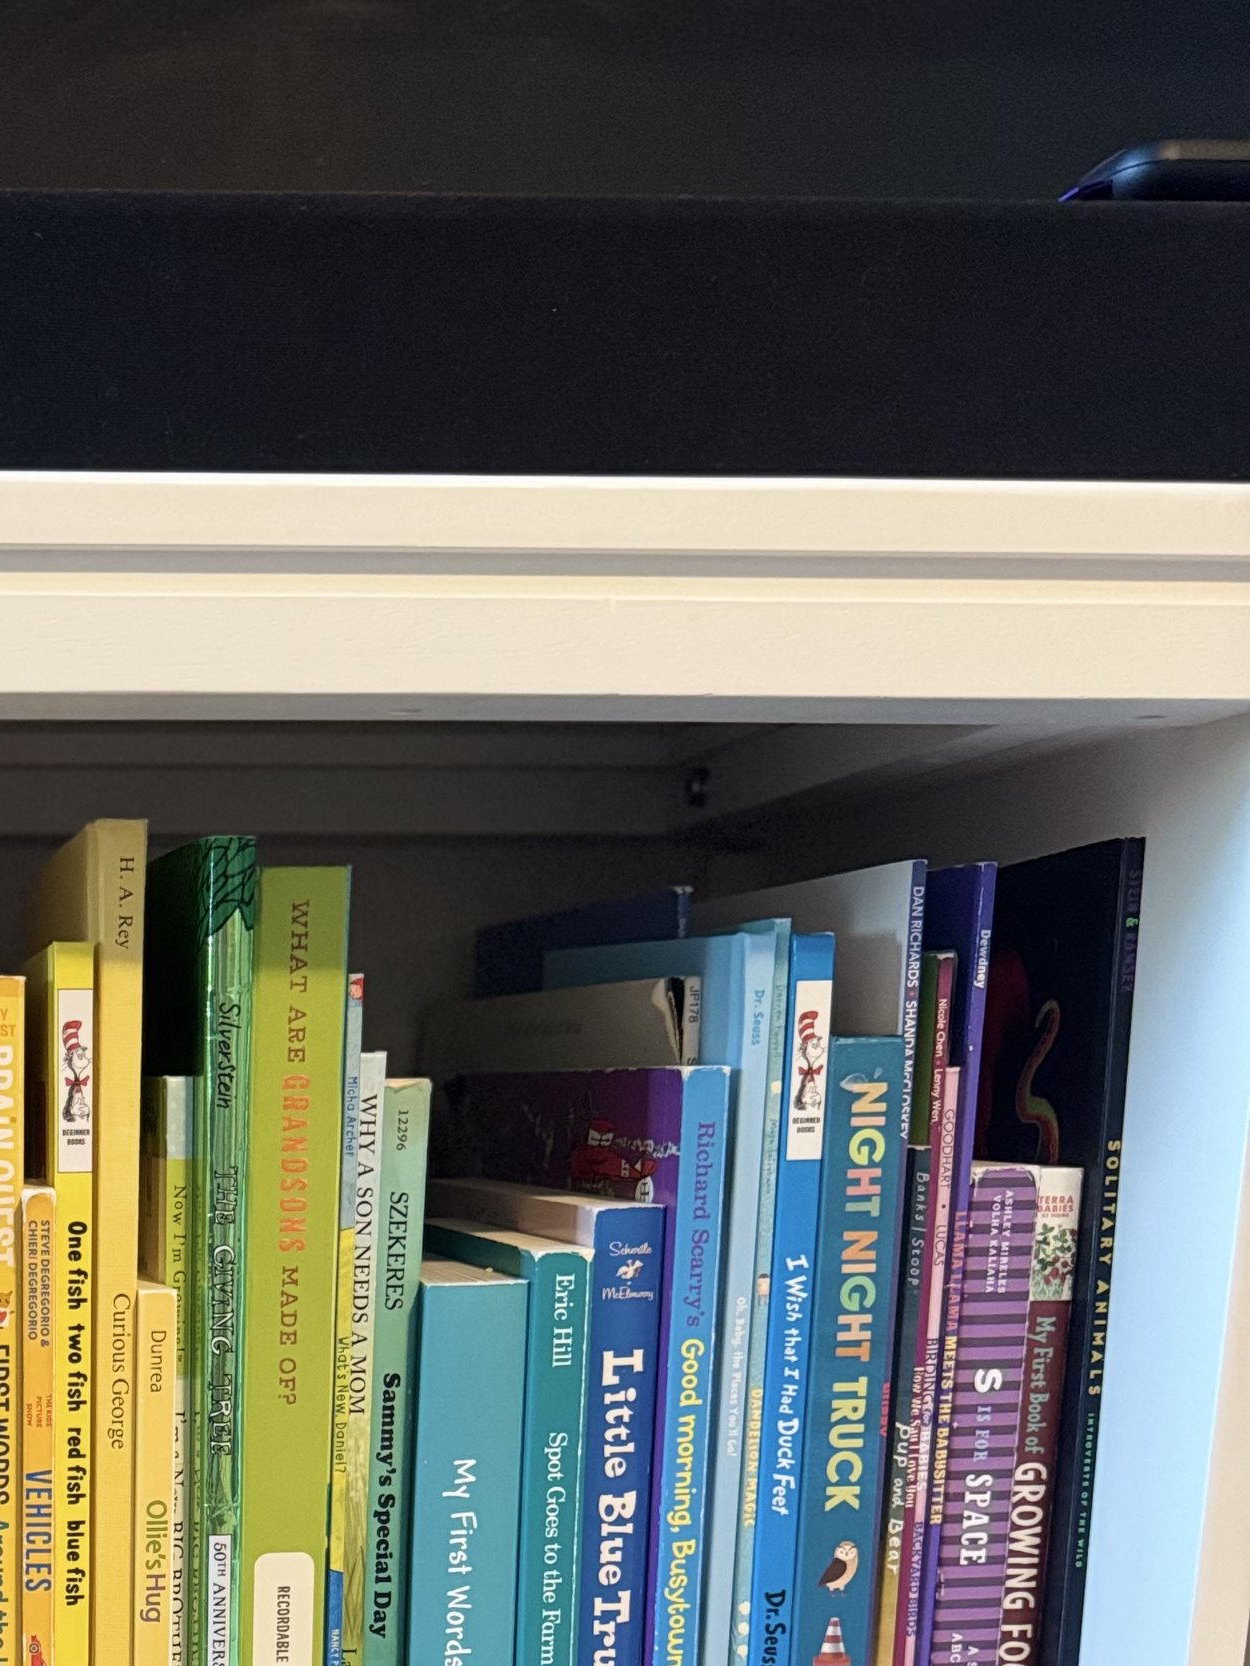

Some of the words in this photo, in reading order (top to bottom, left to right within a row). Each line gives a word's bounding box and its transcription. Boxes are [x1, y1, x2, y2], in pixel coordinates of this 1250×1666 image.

[119, 857, 134, 879] H.
[118, 887, 134, 908] A.
[116, 915, 133, 949] Rey
[291, 899, 310, 992] WHAT
[975, 930, 991, 988] Dewdney
[287, 1005, 307, 1063] ARE
[359, 1095, 377, 1154] WHY
[279, 1074, 311, 1252] GRANDSONS
[358, 1162, 373, 1177] A
[693, 1121, 715, 1220] Richard
[845, 1082, 888, 1217] NIGHT
[213, 1166, 239, 1225] THE
[356, 1187, 374, 1236] SON
[1098, 1140, 1121, 1265] SOLITARY
[67, 1221, 87, 1262] One
[385, 1191, 409, 1310] SZEKERES
[786, 1255, 809, 1270] I
[68, 1269, 88, 1309] fish
[211, 1245, 235, 1355] GIVING
[352, 1245, 371, 1323] NEEDS
[553, 1273, 574, 1320] Eric
[684, 1229, 710, 1327] Scarry's
[784, 1275, 808, 1321] Wish
[835, 1231, 878, 1361] NIGHT
[279, 1266, 299, 1345] MADE
[1038, 1316, 1055, 1342] My
[68, 1324, 84, 1364] two
[111, 1293, 130, 1372] Curious
[351, 1332, 367, 1347] A
[552, 1327, 572, 1368] Hill
[783, 1328, 800, 1361] that
[1088, 1280, 1110, 1396] ANIMALS
[279, 1358, 296, 1405] OF?
[349, 1355, 366, 1415] MOM
[679, 1338, 704, 1406] Good
[784, 1367, 799, 1379] I
[941, 1336, 957, 1387] MEETS
[974, 1368, 1002, 1393] S
[1031, 1347, 1052, 1387] First
[68, 1372, 87, 1411] fish
[109, 1378, 130, 1449] George
[209, 1374, 233, 1456] TREE
[601, 1350, 644, 1477] Little
[779, 1384, 797, 1414] Had
[939, 1392, 953, 1423] THE
[977, 1407, 993, 1422] IS
[1027, 1393, 1047, 1431] Book
[67, 1428, 84, 1459] red
[377, 1373, 401, 1486] Sammy's
[775, 1419, 797, 1469] Duck
[824, 1377, 868, 1512] TRUCK
[973, 1430, 991, 1462] FOR
[1025, 1436, 1042, 1454] of
[442, 1459, 476, 1497] My
[545, 1432, 568, 1480] Spot
[667, 1415, 697, 1532] morning,
[67, 1465, 86, 1505] fish
[771, 1473, 796, 1515] Feet
[25, 1469, 52, 1591] VEHICLES
[545, 1486, 564, 1537] Goes
[959, 1473, 994, 1565] SPACE
[1002, 1462, 1048, 1609] GROWING
[67, 1520, 85, 1562] blue
[373, 1494, 400, 1582] Special
[447, 1511, 477, 1574] First
[544, 1543, 561, 1564] to
[598, 1490, 638, 1585] Blue
[65, 1567, 85, 1606] fish
[542, 1570, 562, 1603] the
[276, 1586, 290, 1663] RECORDABLE
[370, 1591, 392, 1639] Day
[540, 1609, 560, 1666] Farm
[950, 1633, 963, 1663] ABC
[967, 1646, 979, 1655] A
